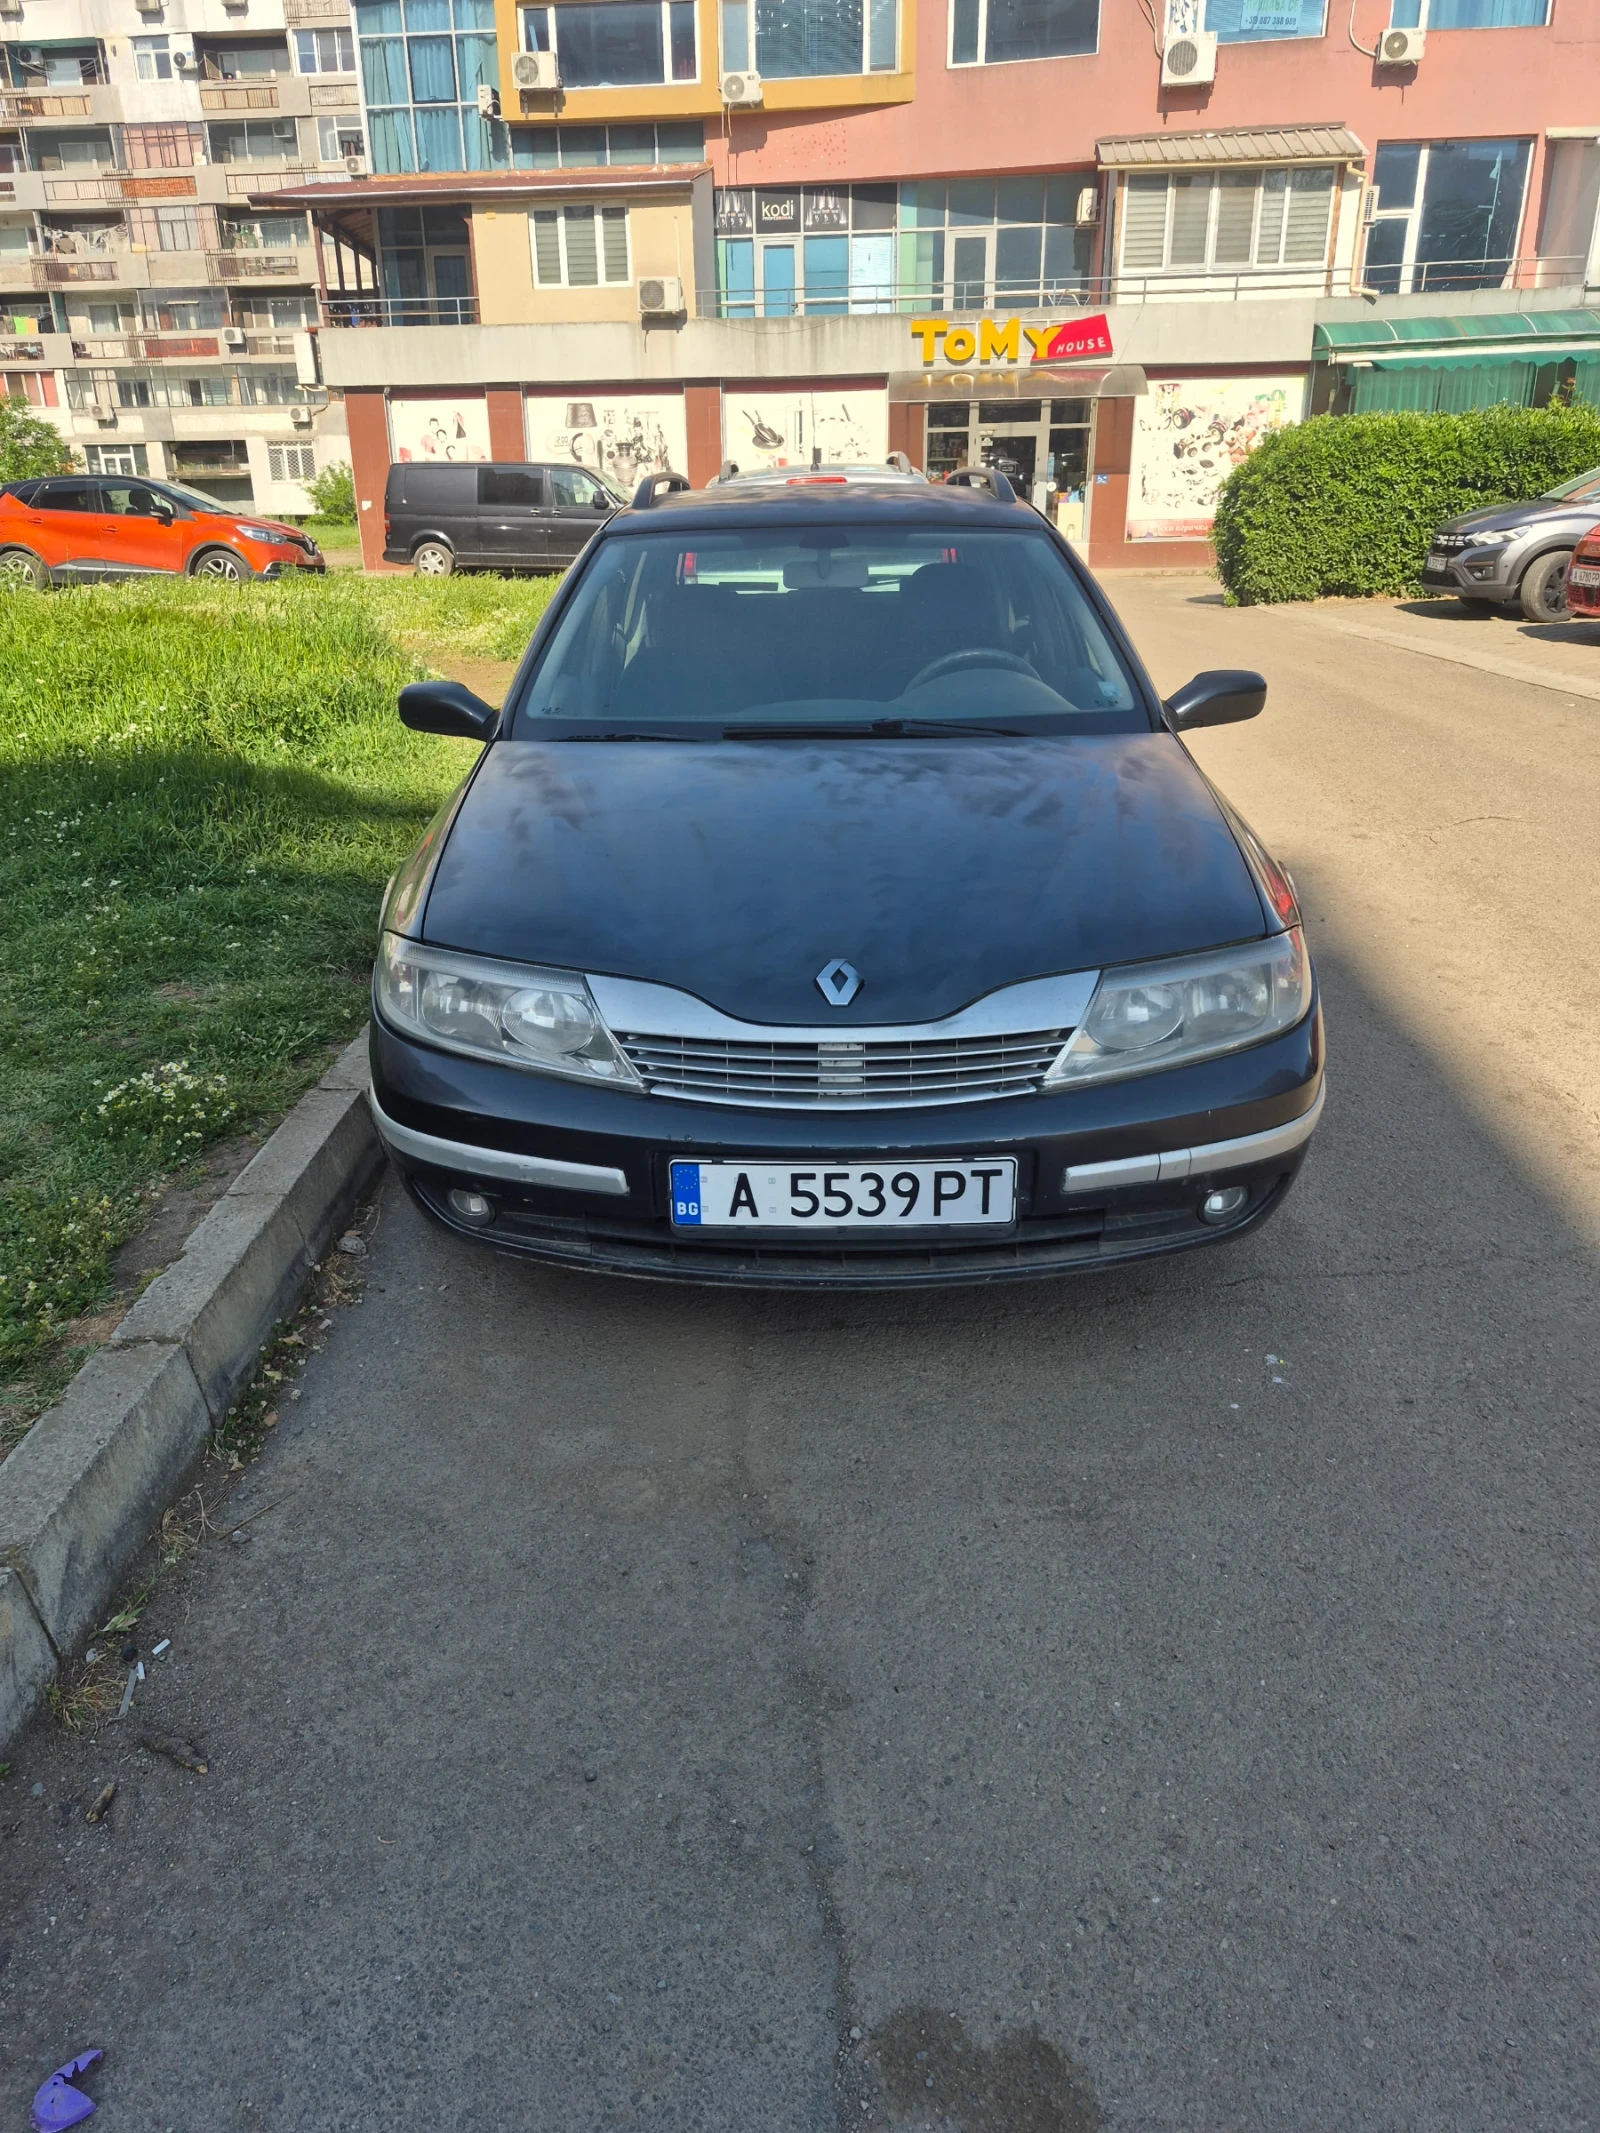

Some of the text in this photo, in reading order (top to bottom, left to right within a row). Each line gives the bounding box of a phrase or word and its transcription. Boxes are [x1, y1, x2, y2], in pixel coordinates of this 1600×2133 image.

[761, 199, 794, 216] kodi
[1056, 336, 1106, 354] HOUSE
[729, 1172, 759, 1218] A
[676, 1201, 698, 1215] BG
